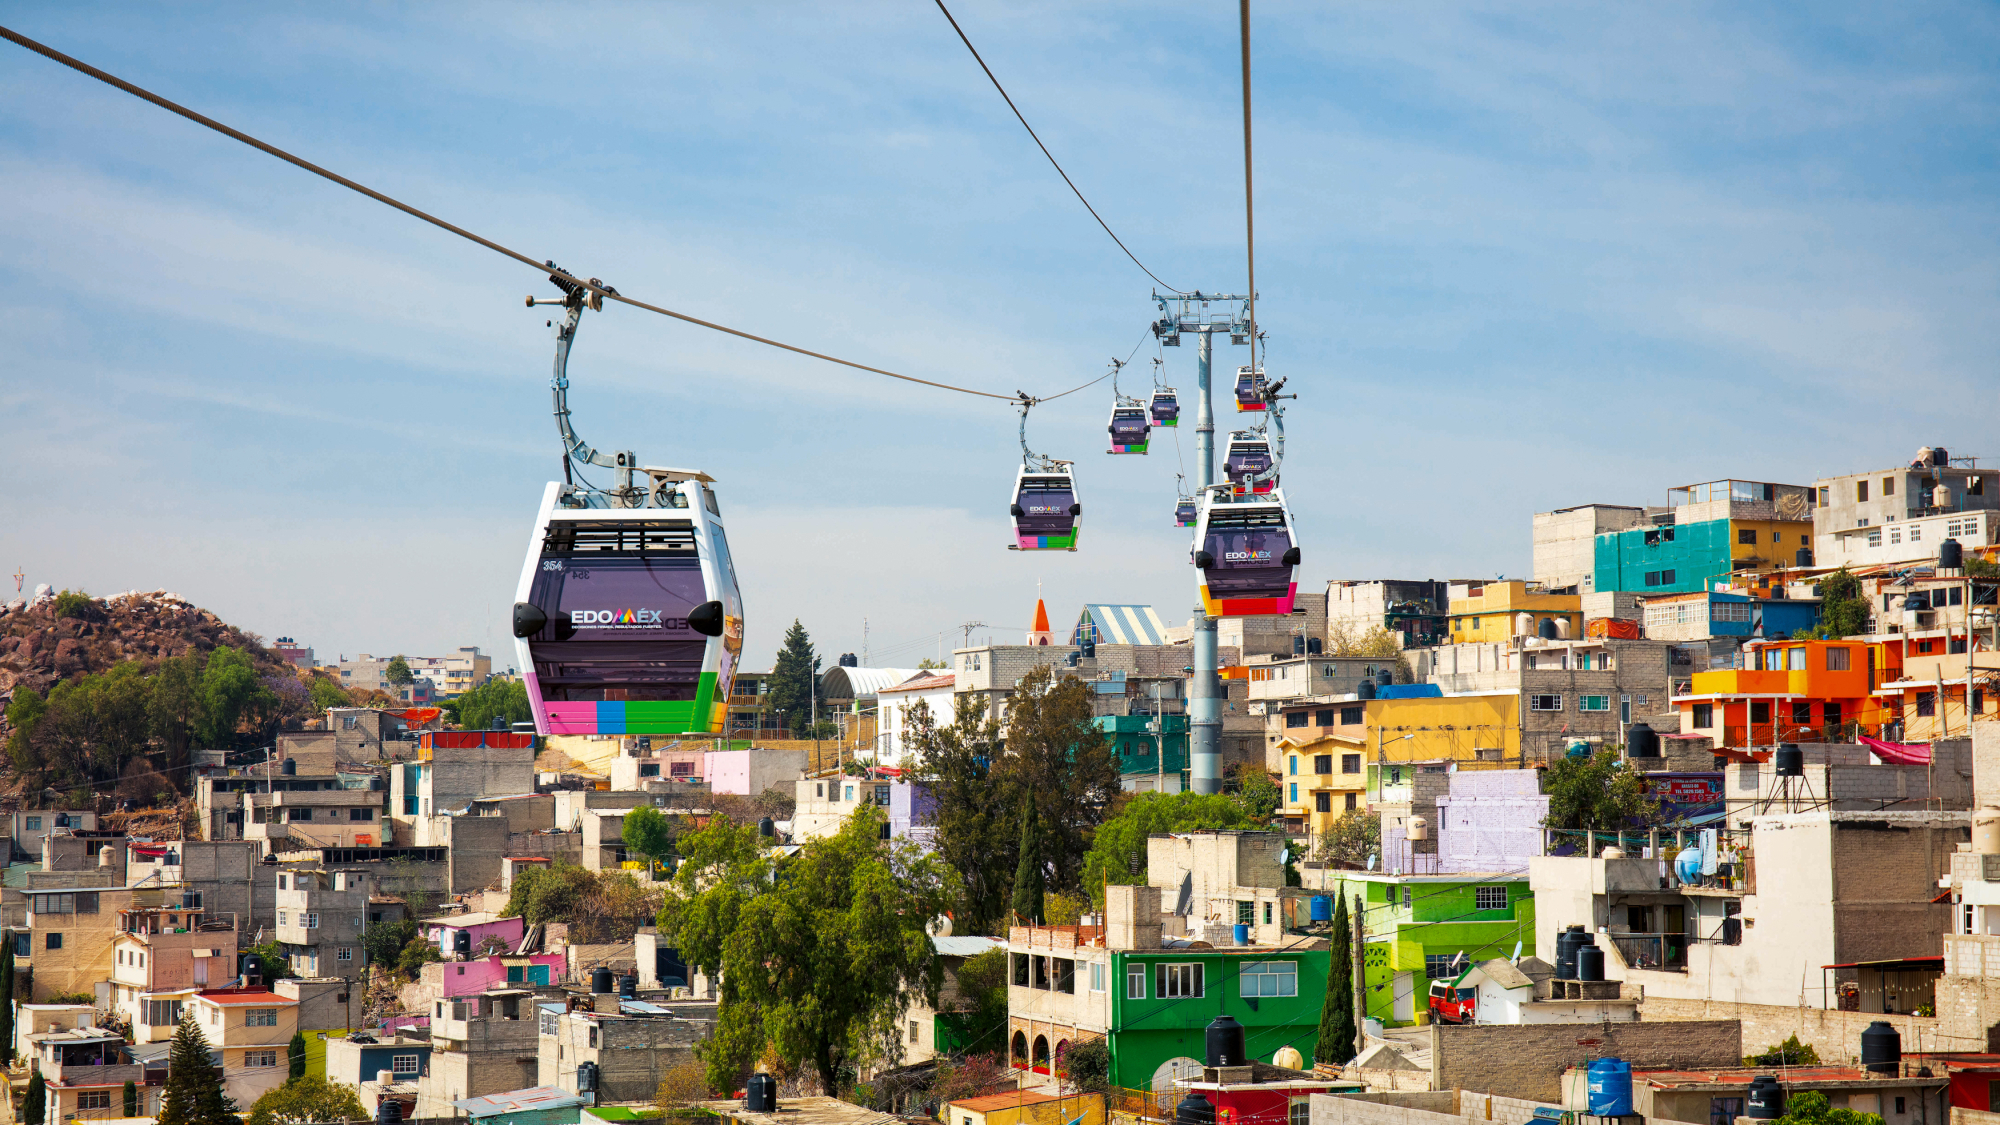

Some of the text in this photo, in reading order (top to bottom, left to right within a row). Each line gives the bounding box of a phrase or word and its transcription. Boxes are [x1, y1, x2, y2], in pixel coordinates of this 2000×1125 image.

[1225, 550, 1272, 559] EDOMÉX
[543, 560, 563, 571] 354
[571, 608, 662, 624] EDOMÉX
